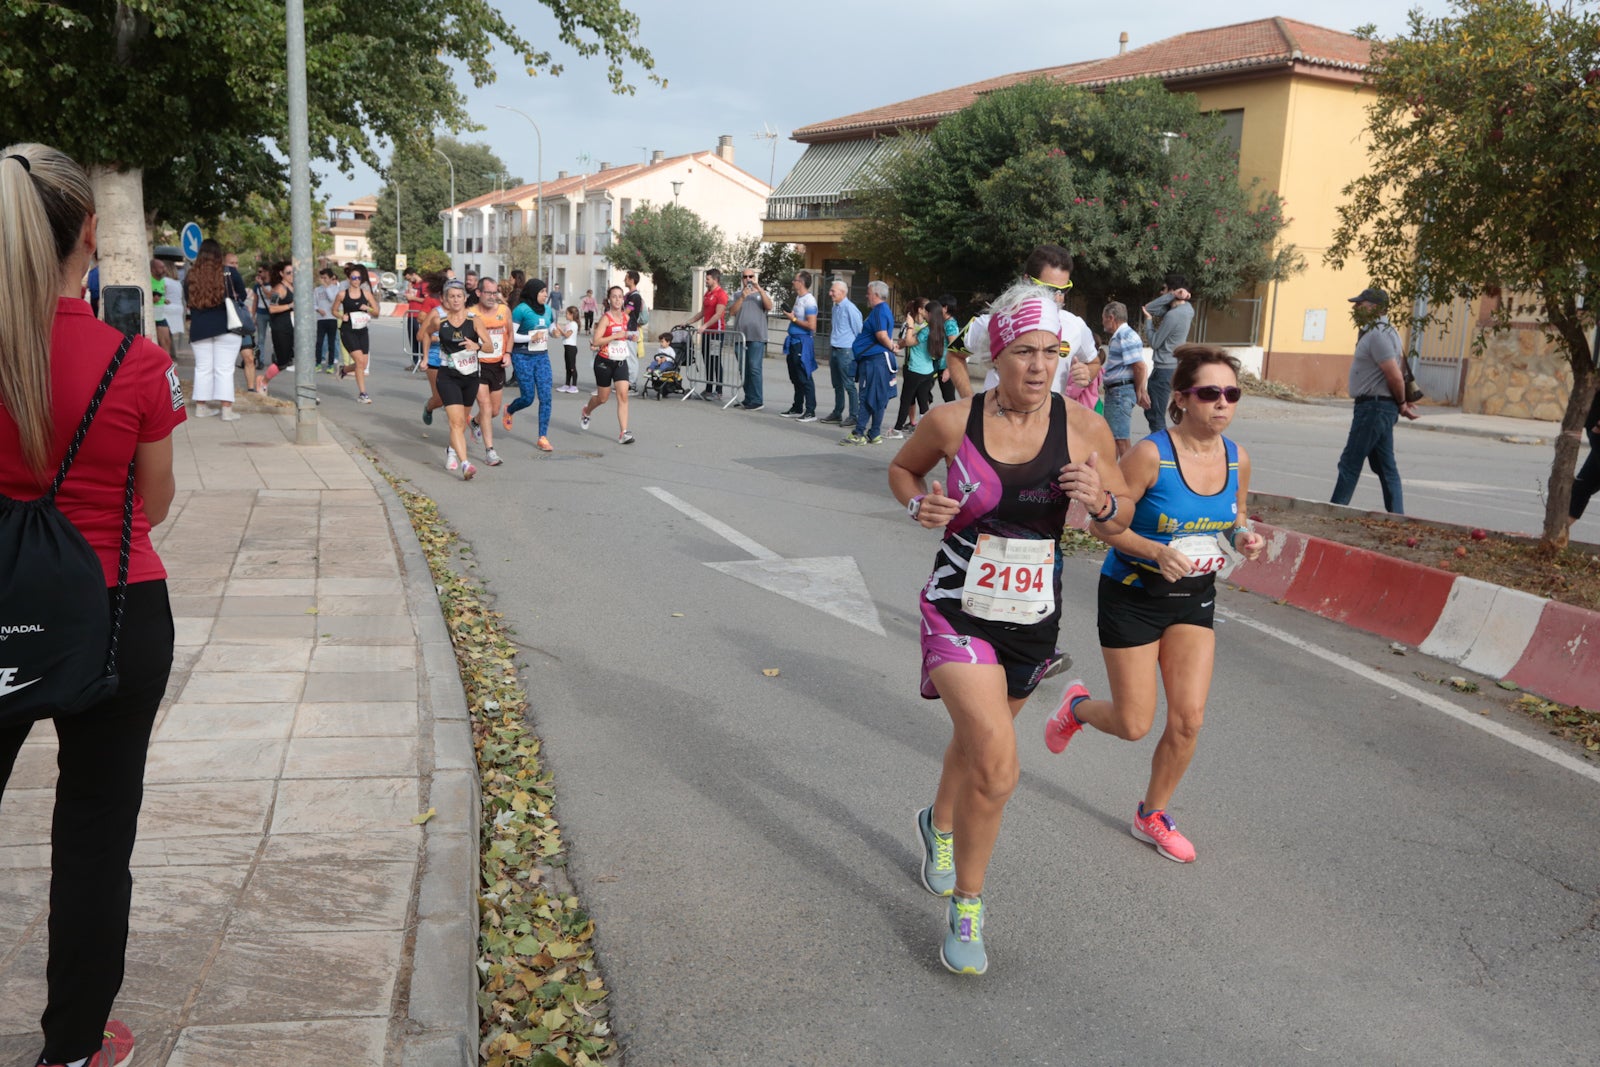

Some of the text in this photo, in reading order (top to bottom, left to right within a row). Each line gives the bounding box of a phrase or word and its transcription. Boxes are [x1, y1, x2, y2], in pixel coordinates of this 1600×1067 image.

[611, 346, 627, 354] 2101
[976, 562, 1044, 593] 2194
[0, 624, 45, 634] NADAL
